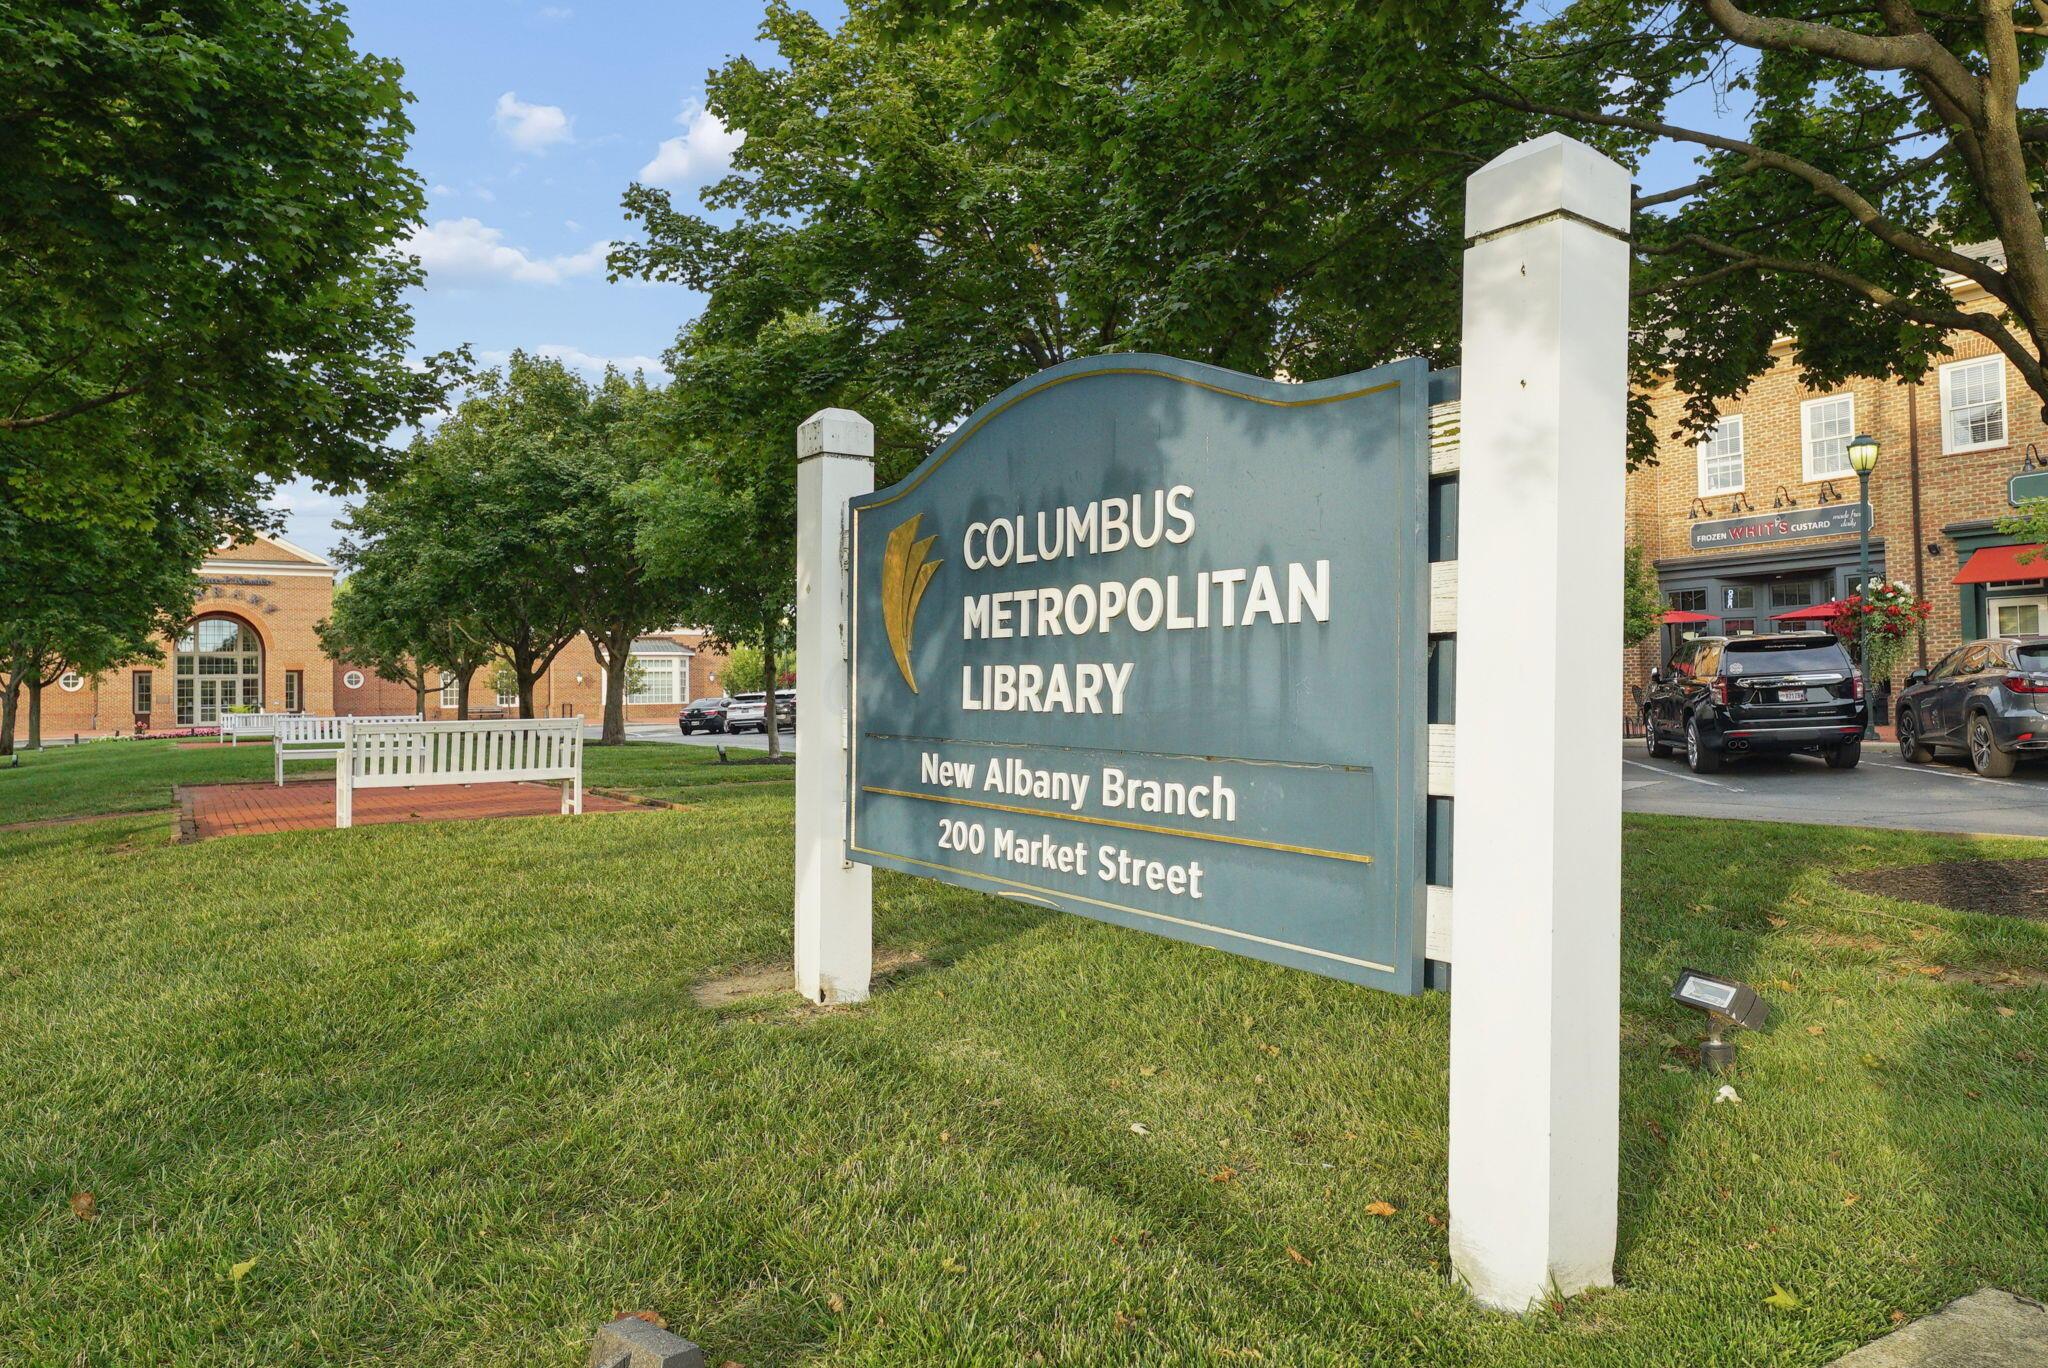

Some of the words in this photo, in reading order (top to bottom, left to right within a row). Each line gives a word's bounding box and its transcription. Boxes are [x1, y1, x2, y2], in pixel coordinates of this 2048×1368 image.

[963, 485, 1196, 571] COLUMBUS
[1696, 532, 1727, 543] FROZEN
[1728, 517, 1789, 540] WHIT'S
[1790, 520, 1831, 532] CUSTARD
[963, 560, 1330, 640] METROPOLITAN
[962, 663, 1135, 715] LIBRARY
[921, 752, 975, 789] New
[983, 757, 1090, 811] Albany
[1102, 768, 1236, 822] Branch
[938, 819, 985, 855] 200
[993, 827, 1088, 876] Market
[1098, 845, 1204, 899] Street
